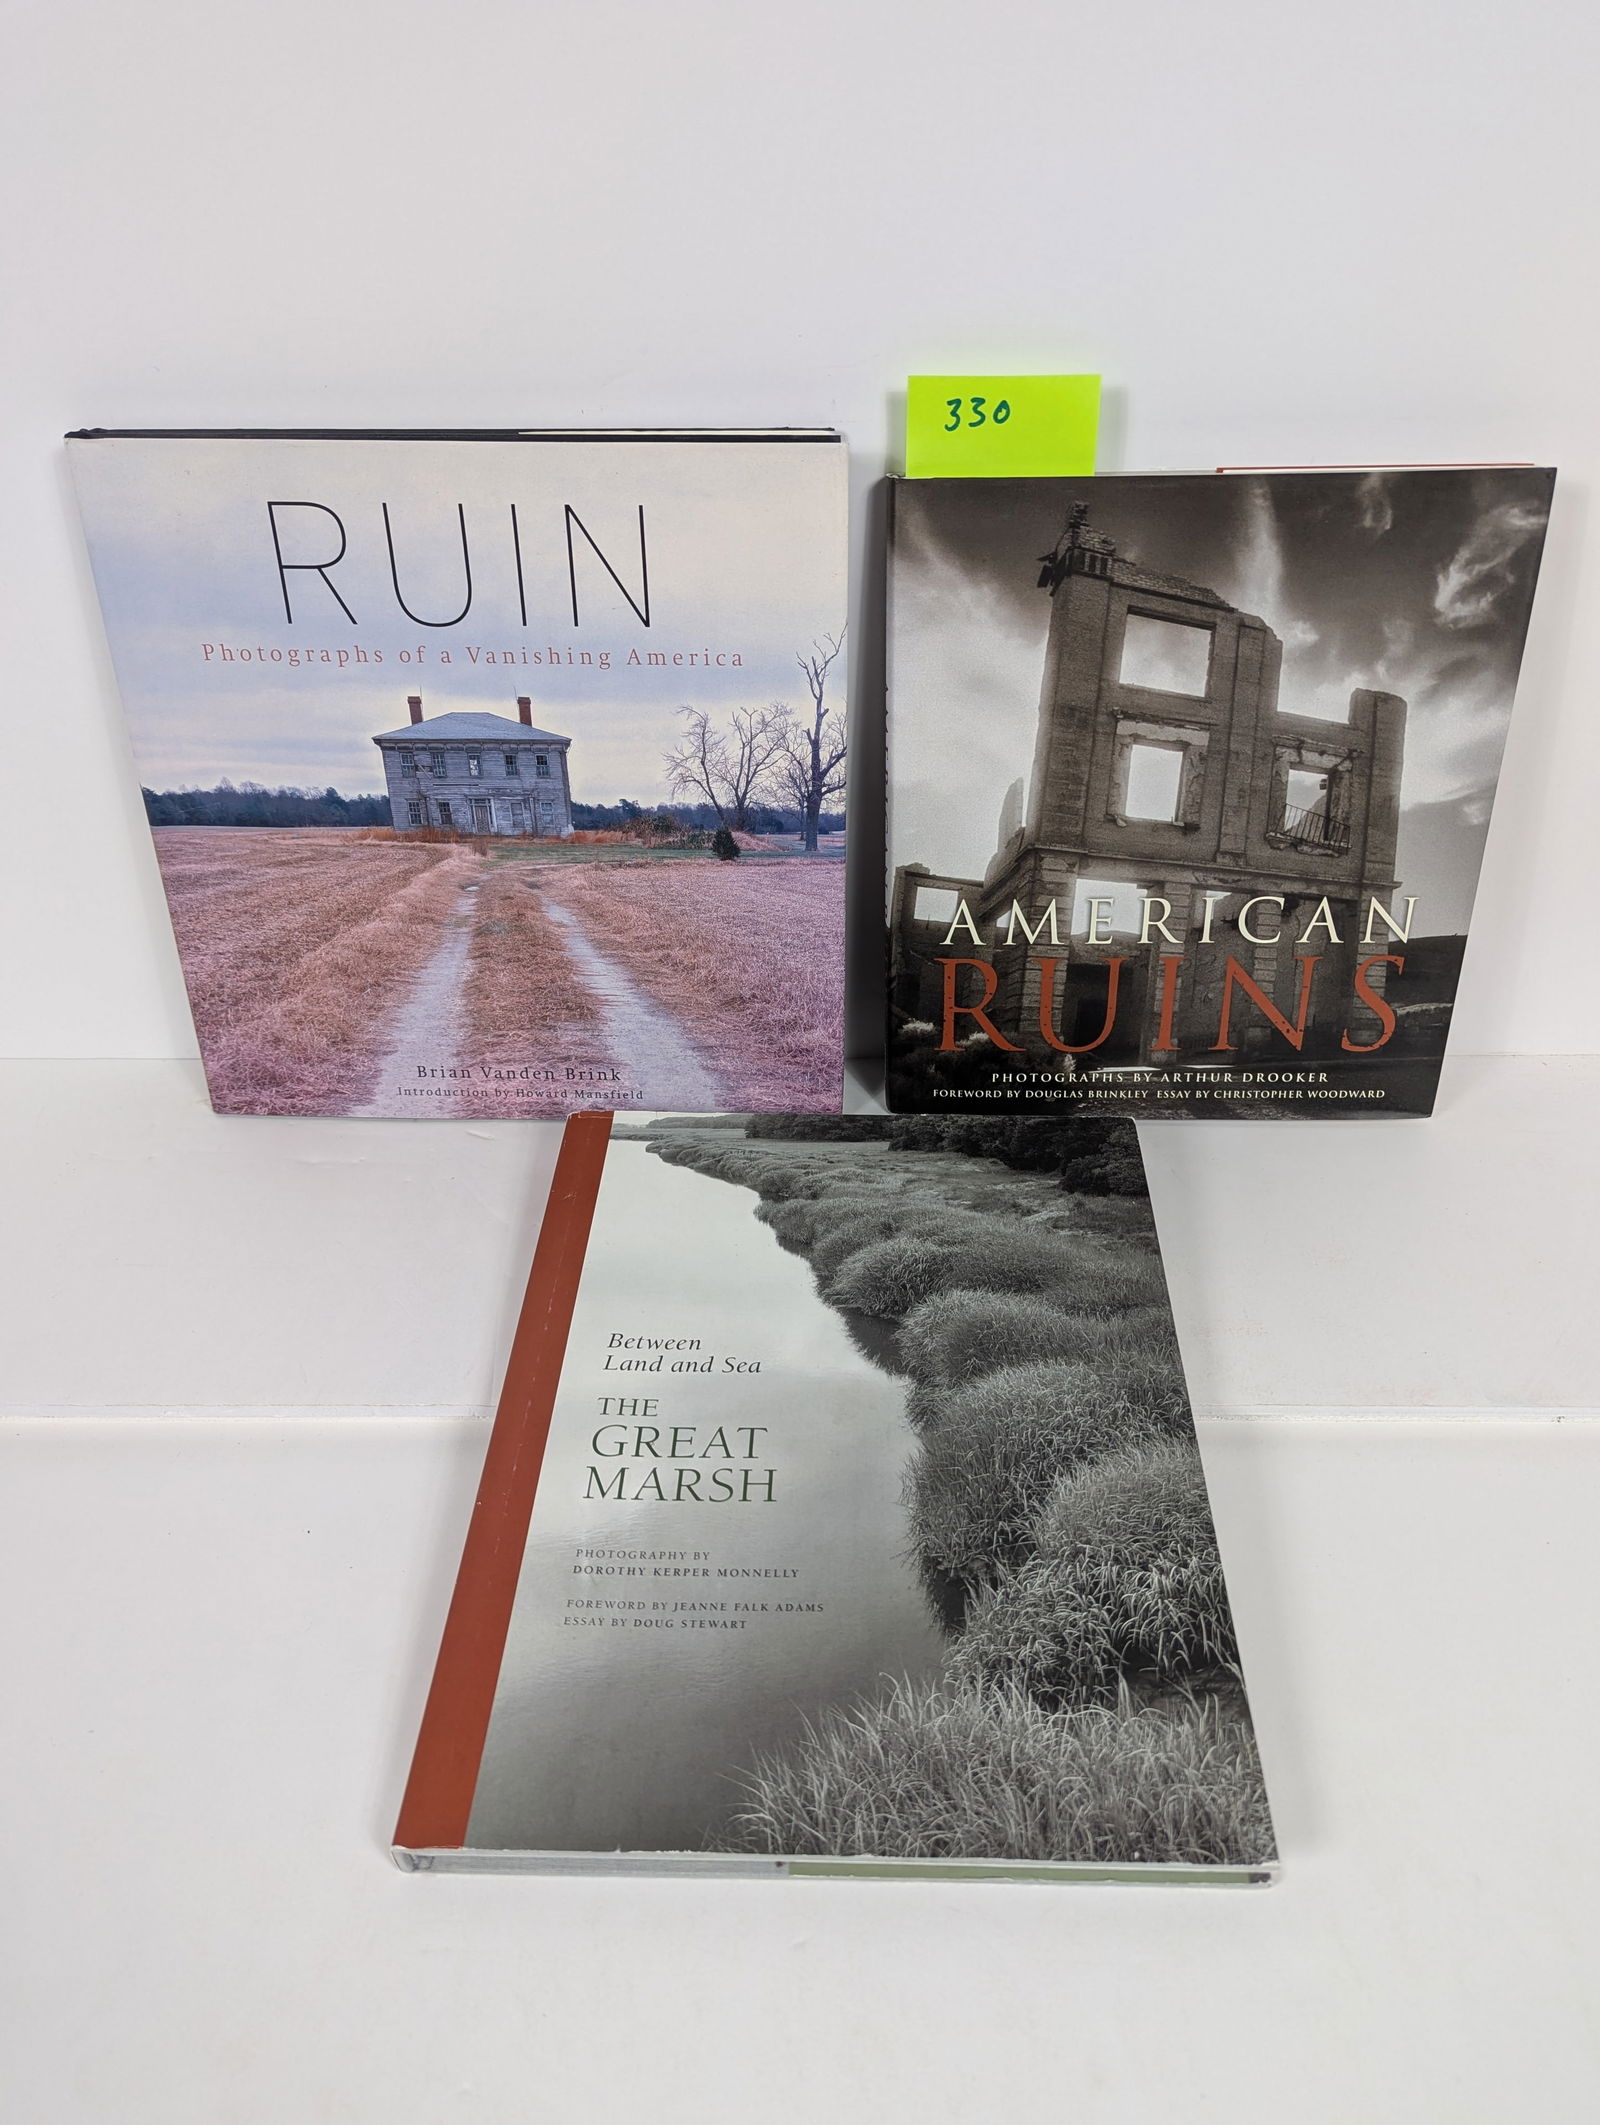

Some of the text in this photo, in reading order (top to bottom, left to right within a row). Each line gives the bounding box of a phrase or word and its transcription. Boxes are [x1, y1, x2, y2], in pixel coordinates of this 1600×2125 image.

[944, 397, 1011, 432] 330
[267, 501, 652, 628] RUIN
[201, 643, 743, 669] Photographs of a Vanishing America
[939, 896, 1420, 946] AMERICAN
[933, 954, 1406, 1053] RUINS
[417, 1065, 622, 1081] Brian Vanden Brink
[992, 1072, 1329, 1083] PHOTOGRAPHS BY ARTHUR DROOKER
[397, 1086, 645, 1100] Introduction by Howard Mansfield
[933, 1089, 1385, 1099] FOREWORD BY DOUGLAS BRINKLEY ESSAY BY CHRISTOPHER WOODWARD
[607, 1332, 702, 1351] Between
[602, 1354, 762, 1374] Land and Sea
[597, 1397, 660, 1417] THE
[591, 1424, 769, 1460] GREAT
[582, 1465, 778, 1503] MARSH
[575, 1549, 711, 1561] PHOTOGRAPHY BY
[572, 1565, 800, 1579] DOROTHY KERPER MONNELLY
[566, 1599, 825, 1613] FOREWORD BY JEANNE FALK ADAMS
[563, 1616, 749, 1630] ESSAY BY DOUG STEWART
